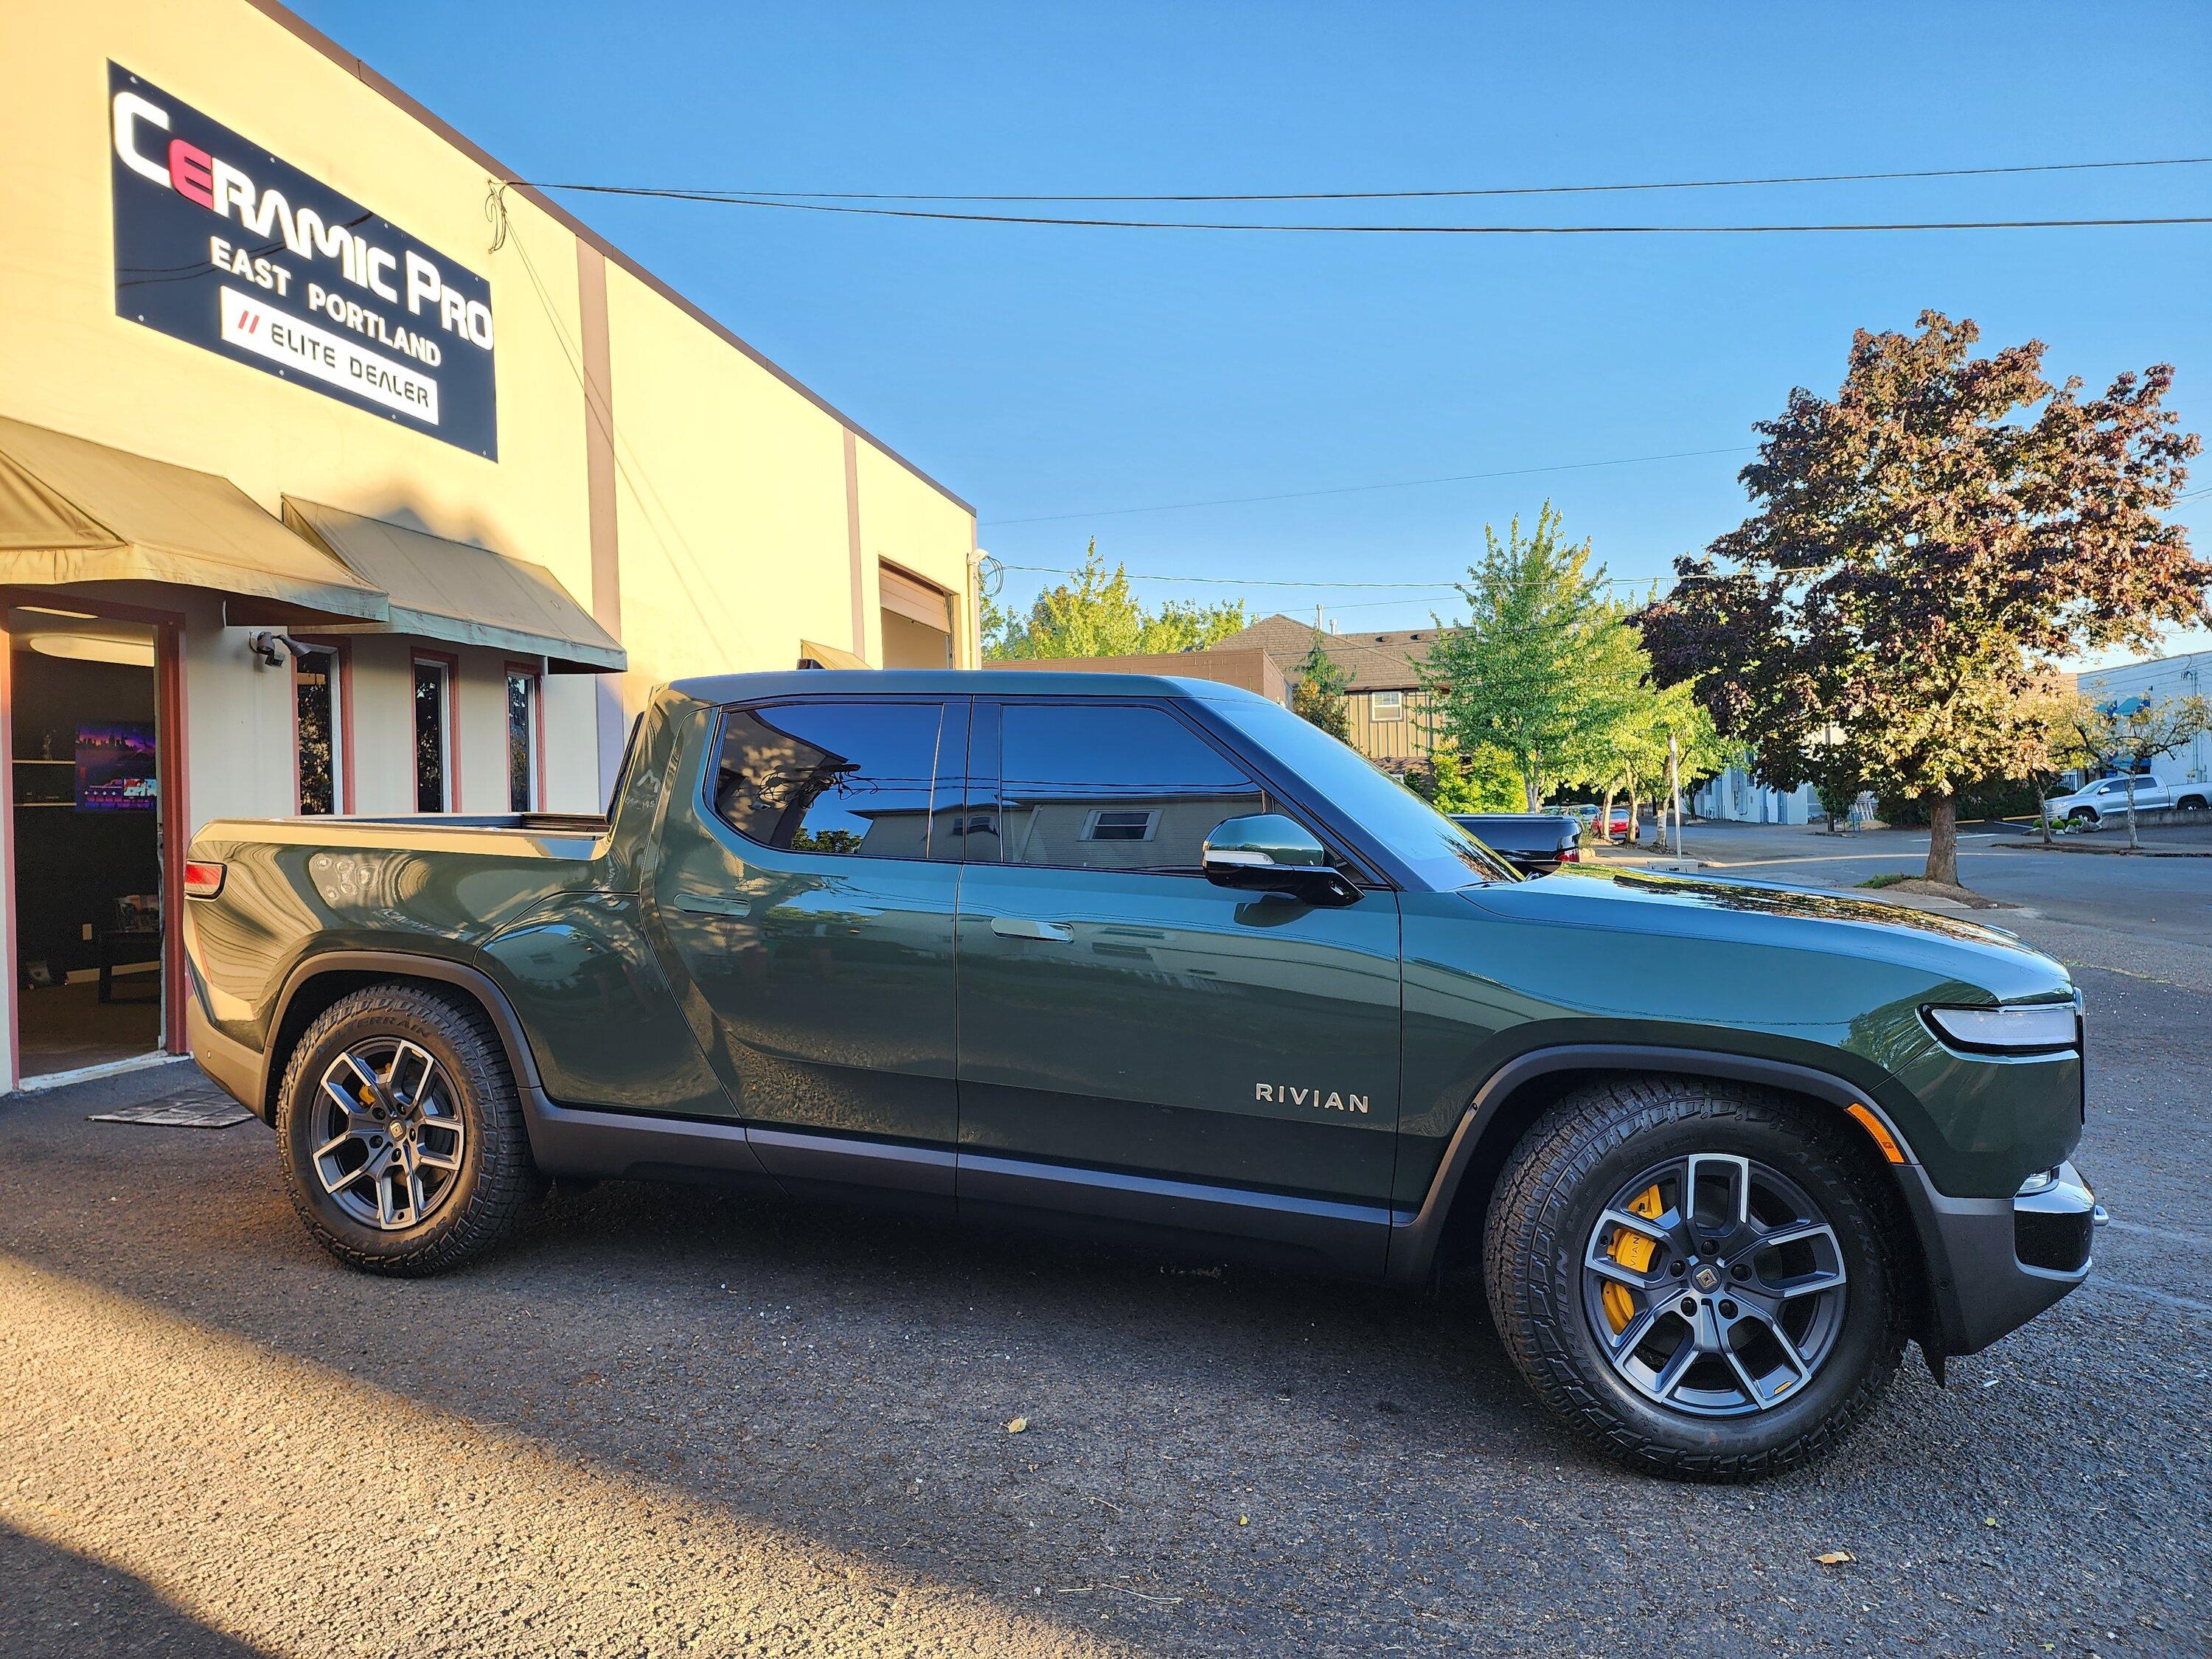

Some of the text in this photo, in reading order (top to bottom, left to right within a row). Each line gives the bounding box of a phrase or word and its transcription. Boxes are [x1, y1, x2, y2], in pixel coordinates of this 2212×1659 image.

[112, 91, 495, 351] CERAMIC PRO
[210, 235, 442, 367] EAST PORTLAND
[271, 322, 429, 408] ELITE DEALER
[344, 1016, 432, 1038] TERRAIN
[1255, 1083, 1368, 1114] RIVIAN
[1628, 1237, 1641, 1267] VIAN
[1554, 1246, 1635, 1417] SCORPION
